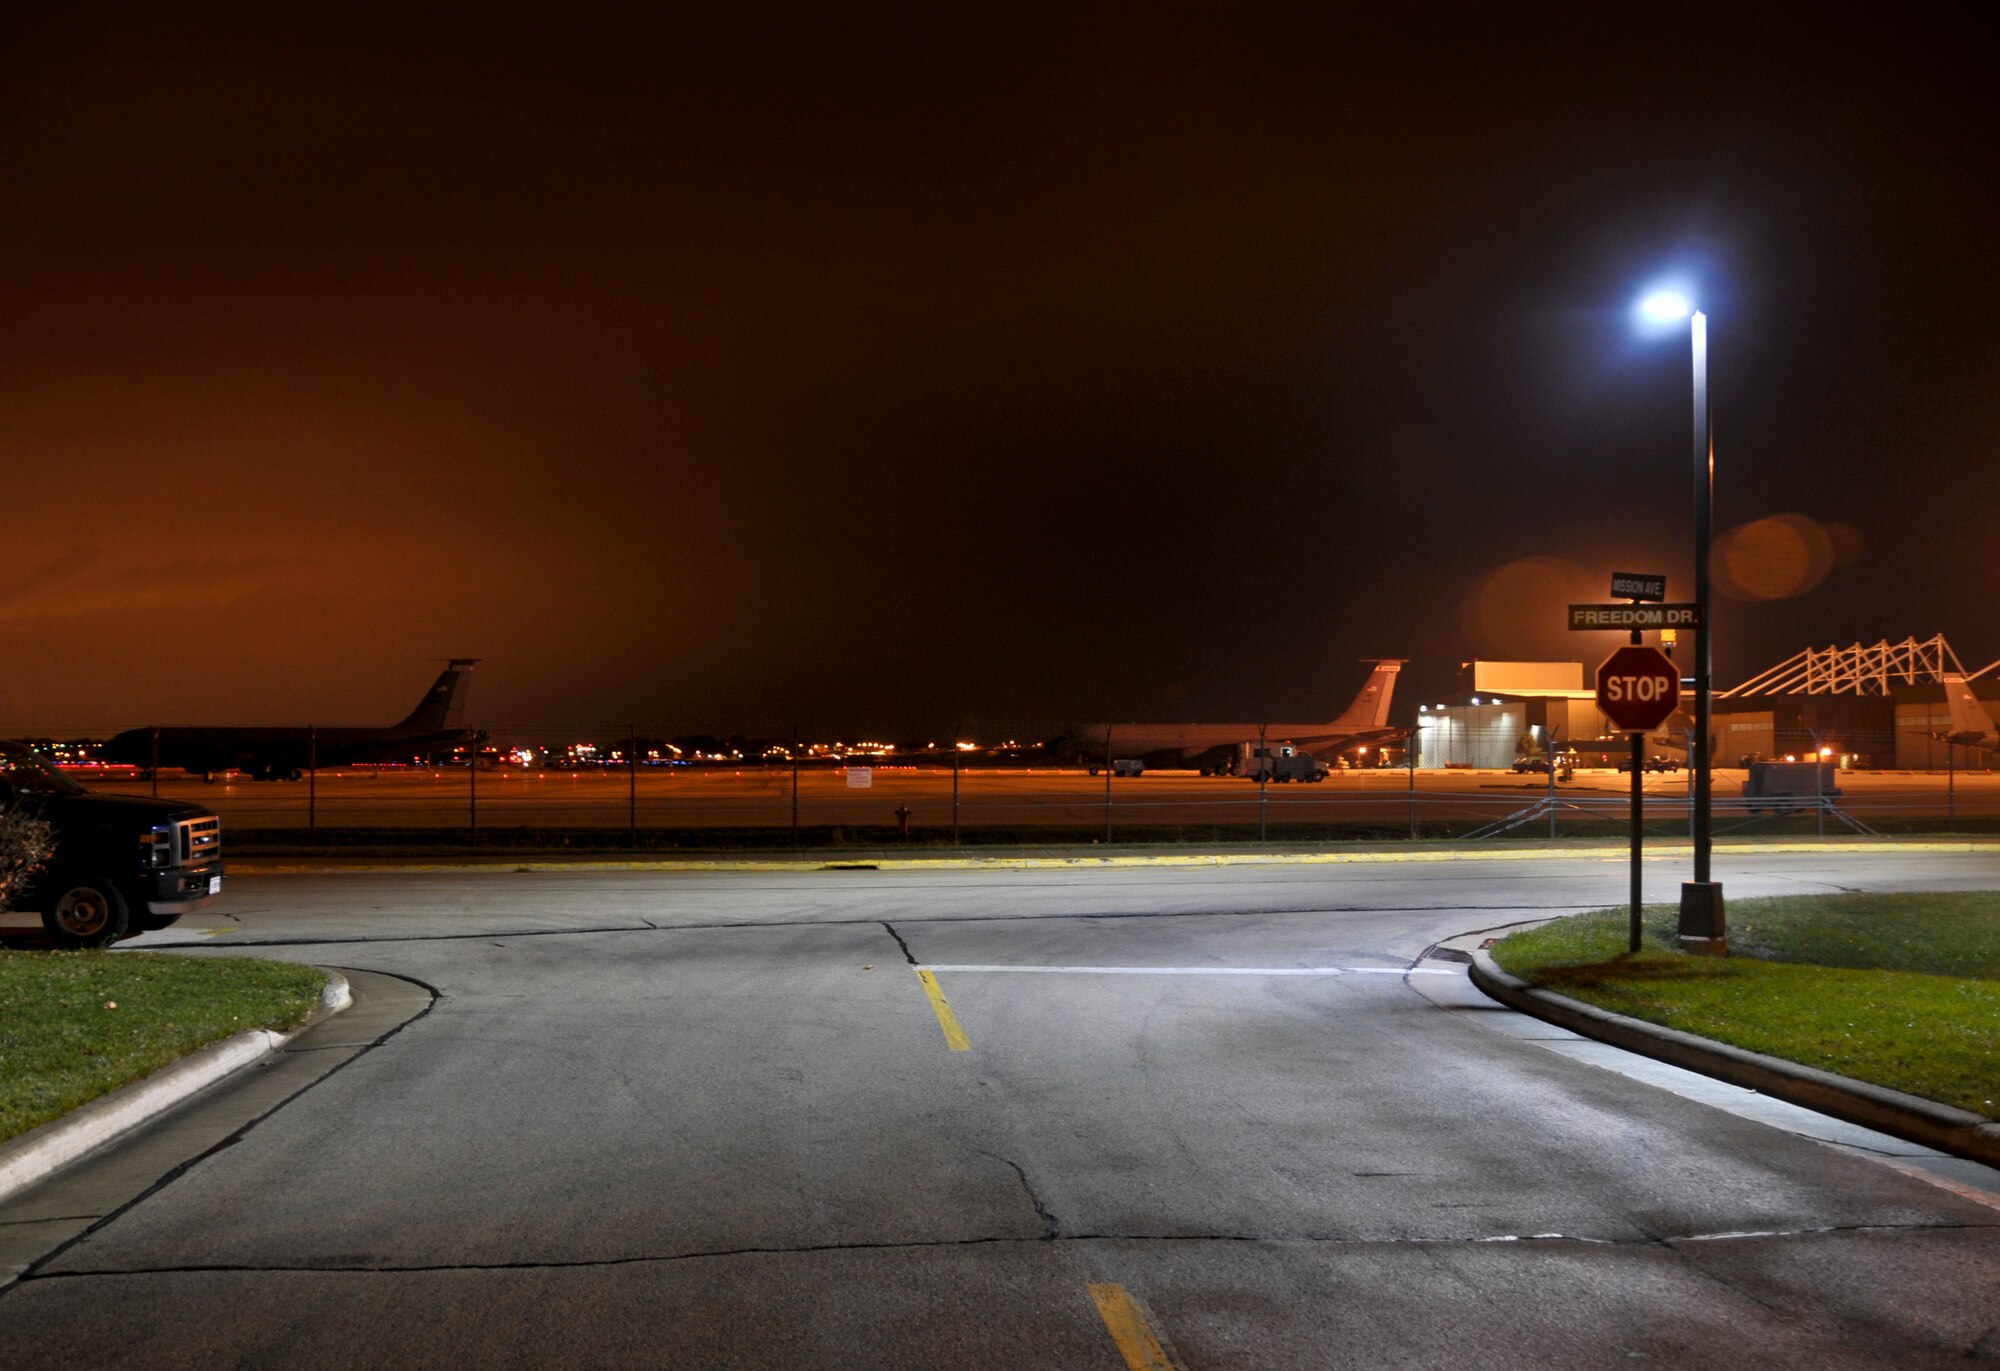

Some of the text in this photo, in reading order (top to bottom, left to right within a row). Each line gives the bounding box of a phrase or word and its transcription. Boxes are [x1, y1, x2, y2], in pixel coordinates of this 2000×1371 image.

[1613, 579, 1643, 594] MISSION
[1574, 610, 1698, 624] FREEDOM DR.
[1607, 676, 1669, 701] STOP
